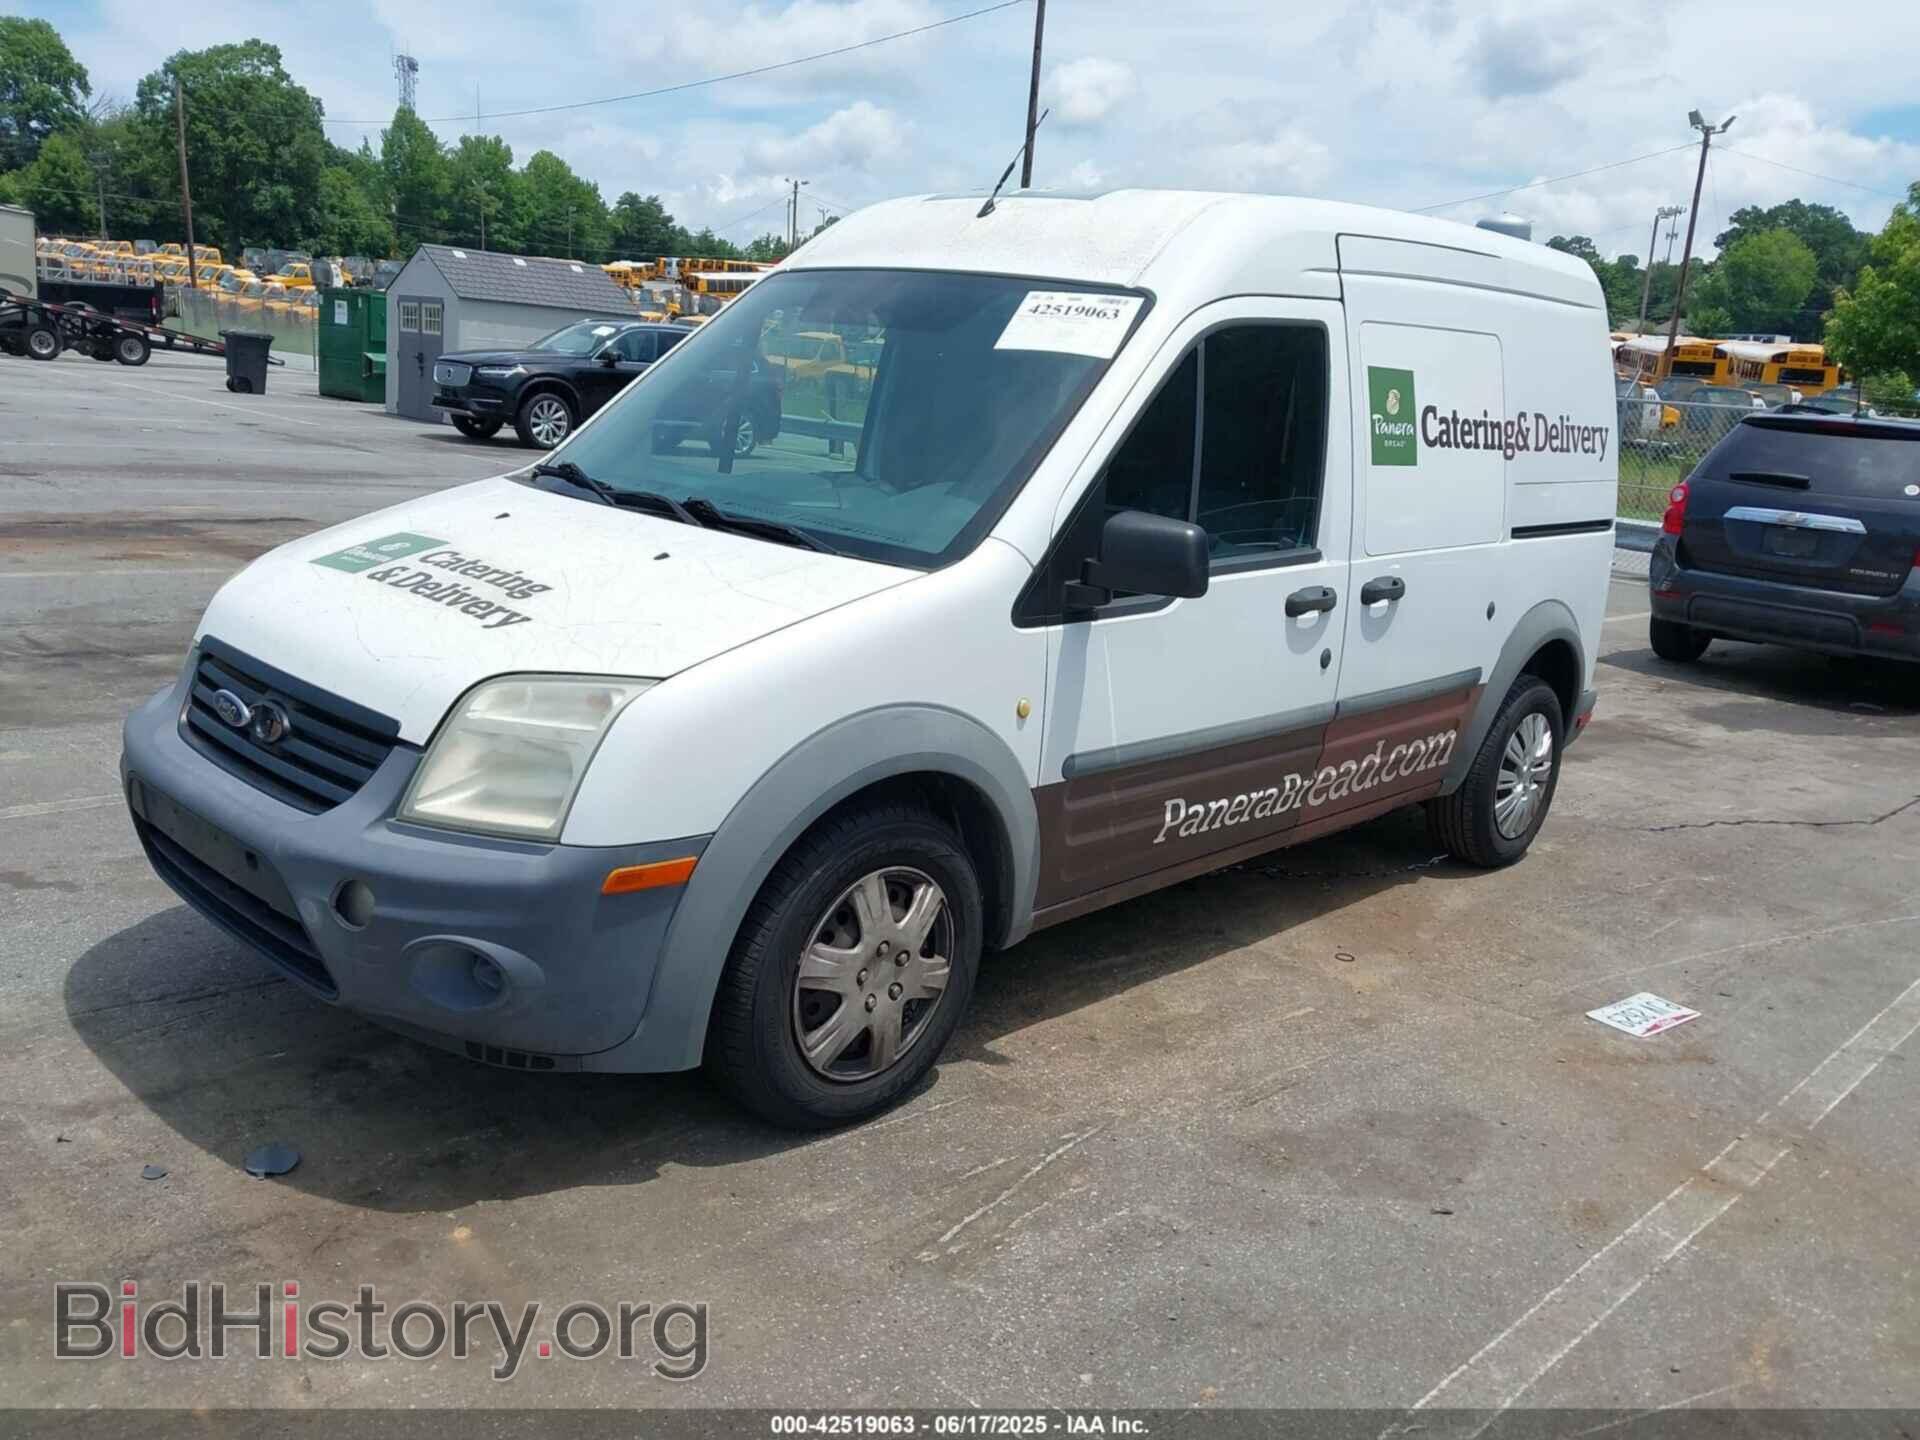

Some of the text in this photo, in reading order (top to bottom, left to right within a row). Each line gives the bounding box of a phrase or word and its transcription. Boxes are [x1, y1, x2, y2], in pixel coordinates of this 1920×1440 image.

[1028, 303, 1120, 320] 42519063
[1372, 413, 1415, 436] Panera
[418, 551, 553, 599] Catering
[1153, 728, 1457, 844] PaneraBread.com
